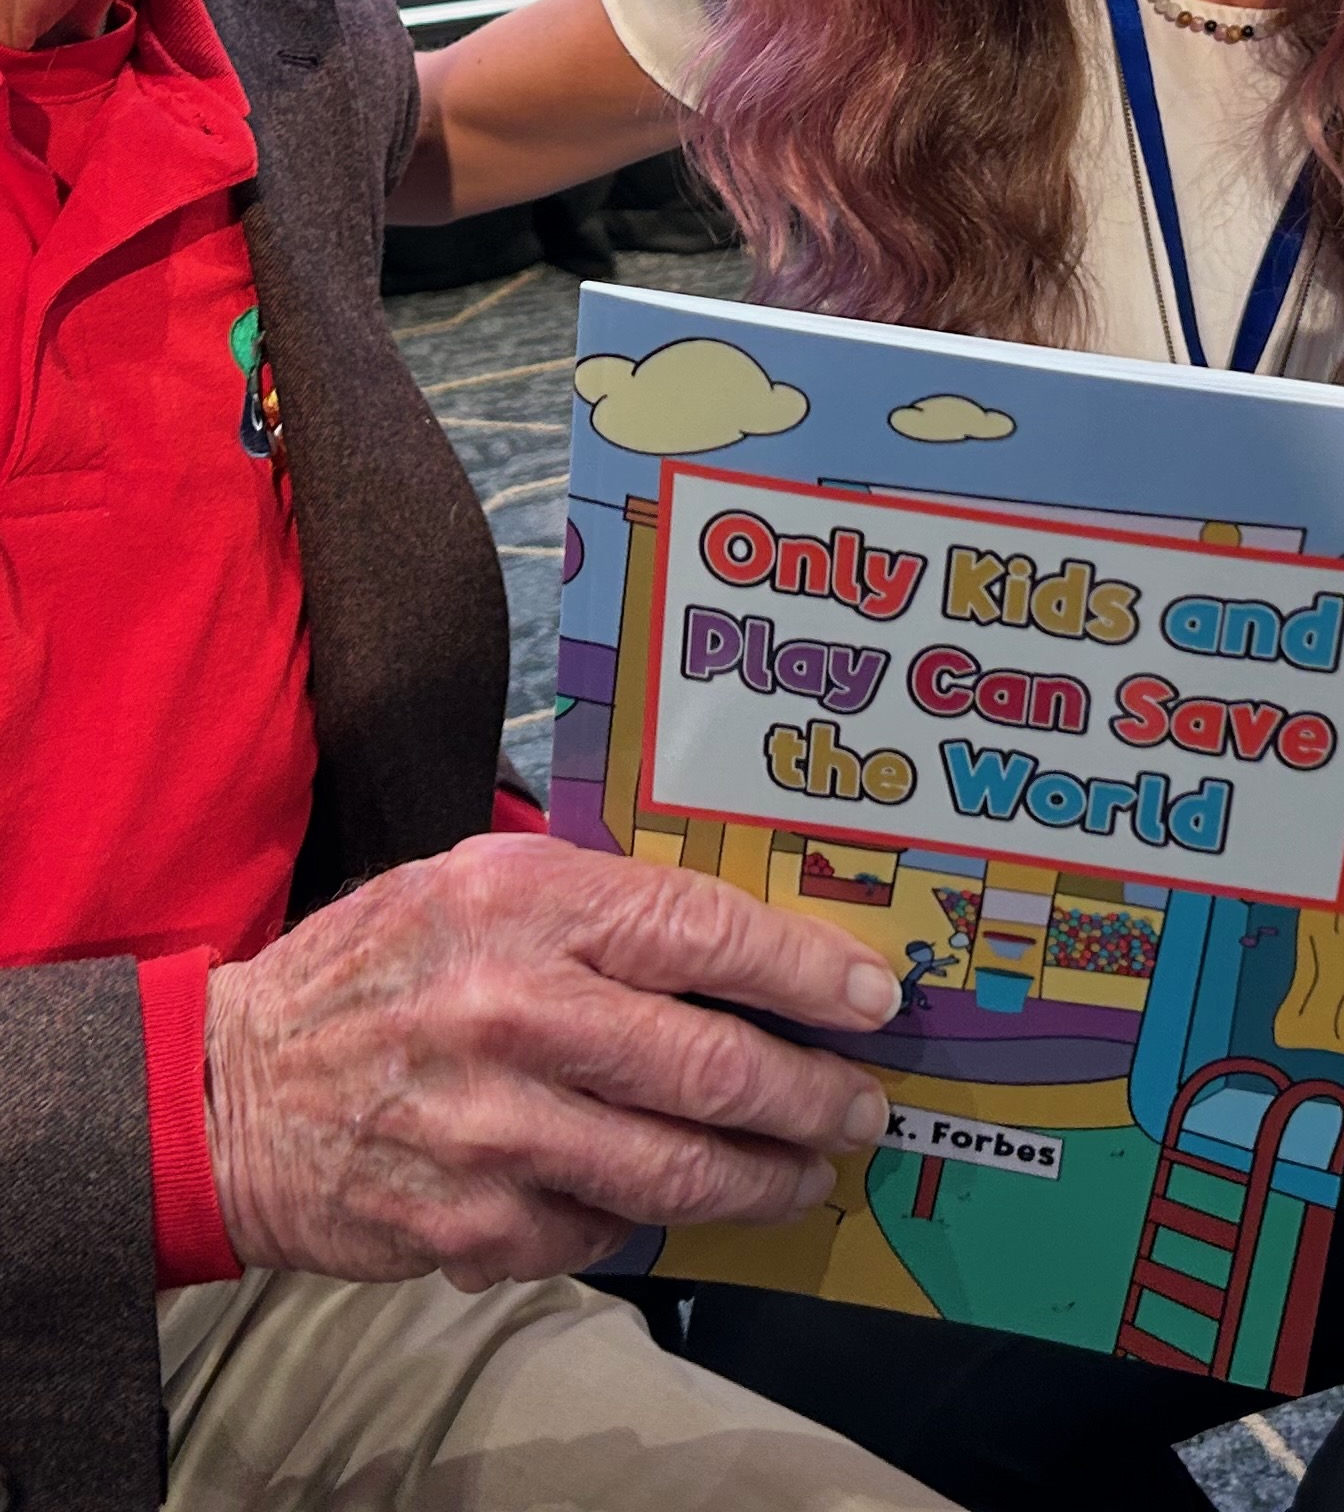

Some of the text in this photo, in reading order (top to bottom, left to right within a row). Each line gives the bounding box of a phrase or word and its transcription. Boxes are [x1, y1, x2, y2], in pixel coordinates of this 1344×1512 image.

[699, 509, 927, 622] Only
[942, 545, 1141, 646] Kids
[681, 605, 1339, 772] Play Can Save
[764, 719, 1235, 857] the World
[930, 1120, 1056, 1167] Forbes
